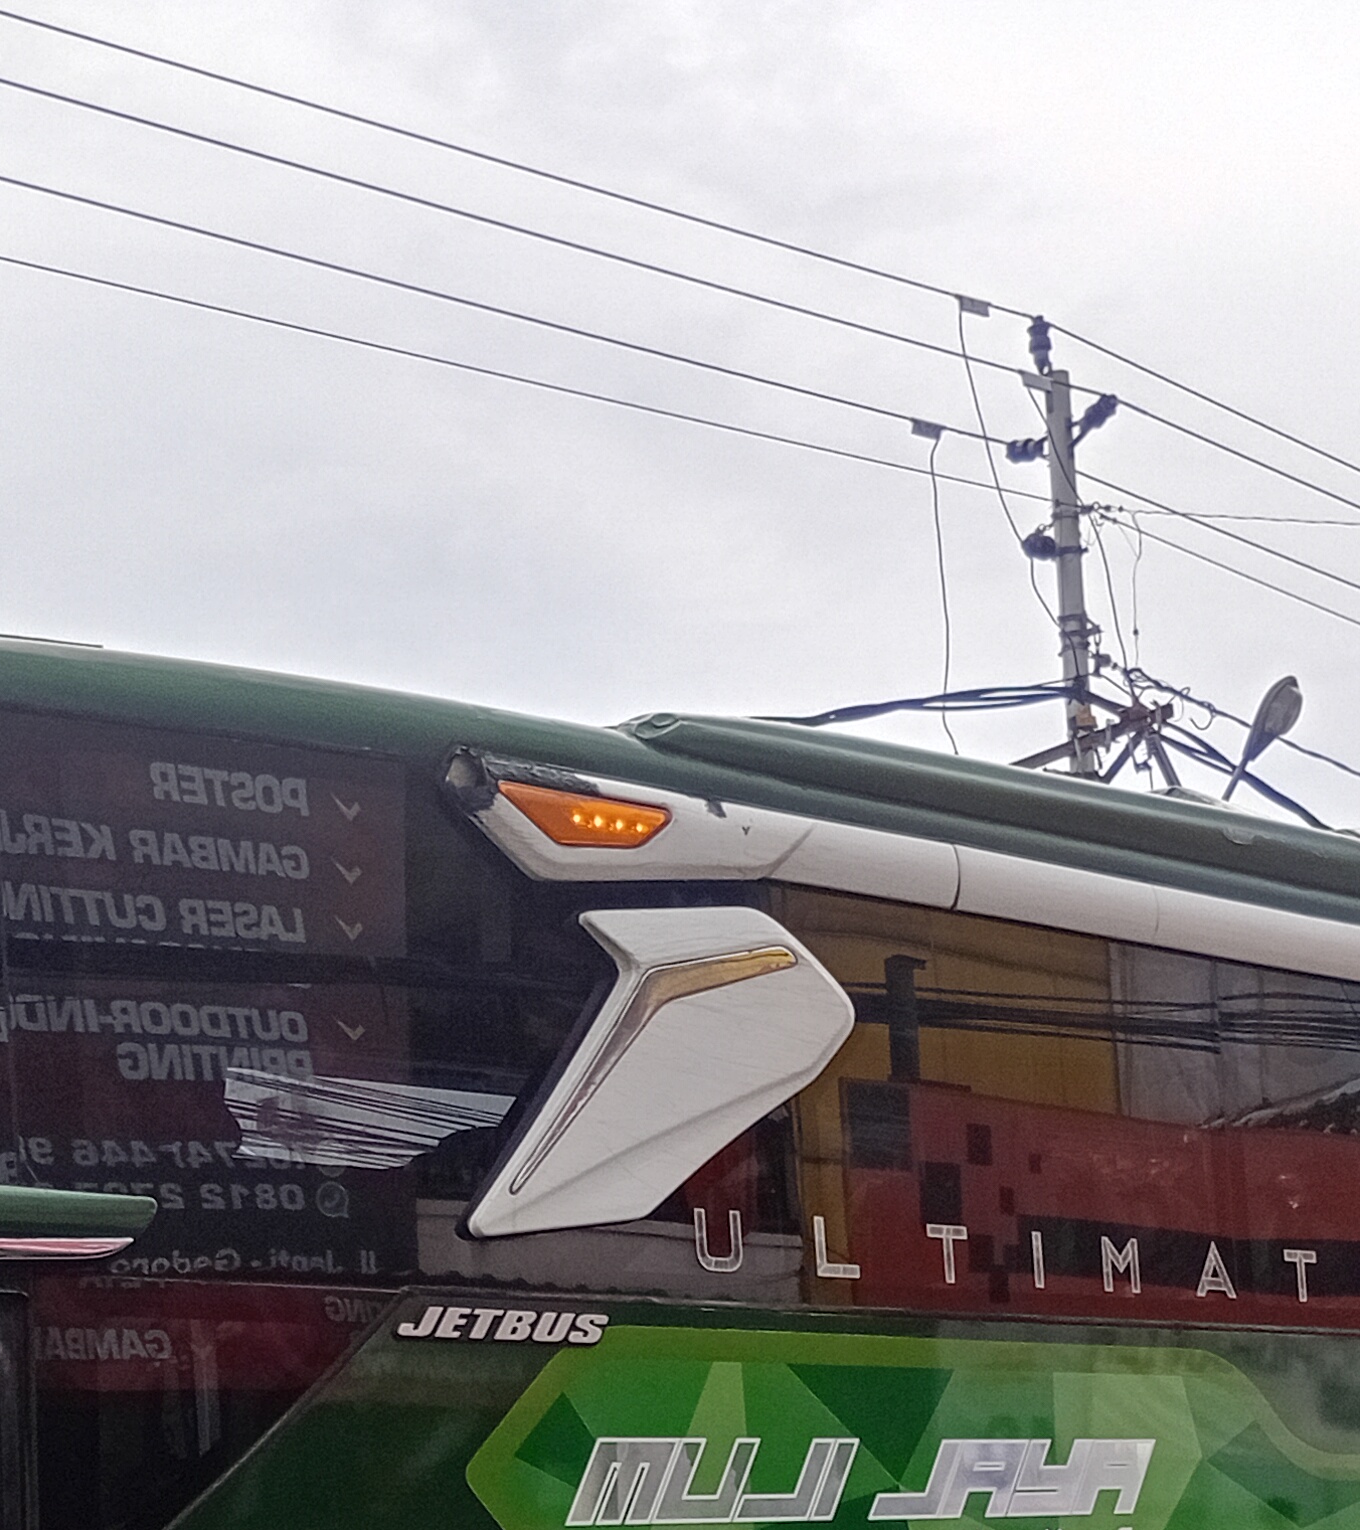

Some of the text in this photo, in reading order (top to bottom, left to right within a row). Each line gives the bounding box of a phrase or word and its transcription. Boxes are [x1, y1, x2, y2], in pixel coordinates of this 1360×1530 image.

[396, 1306, 610, 1345] JETBUS
[565, 1437, 1157, 1527] MUJI JAYA
